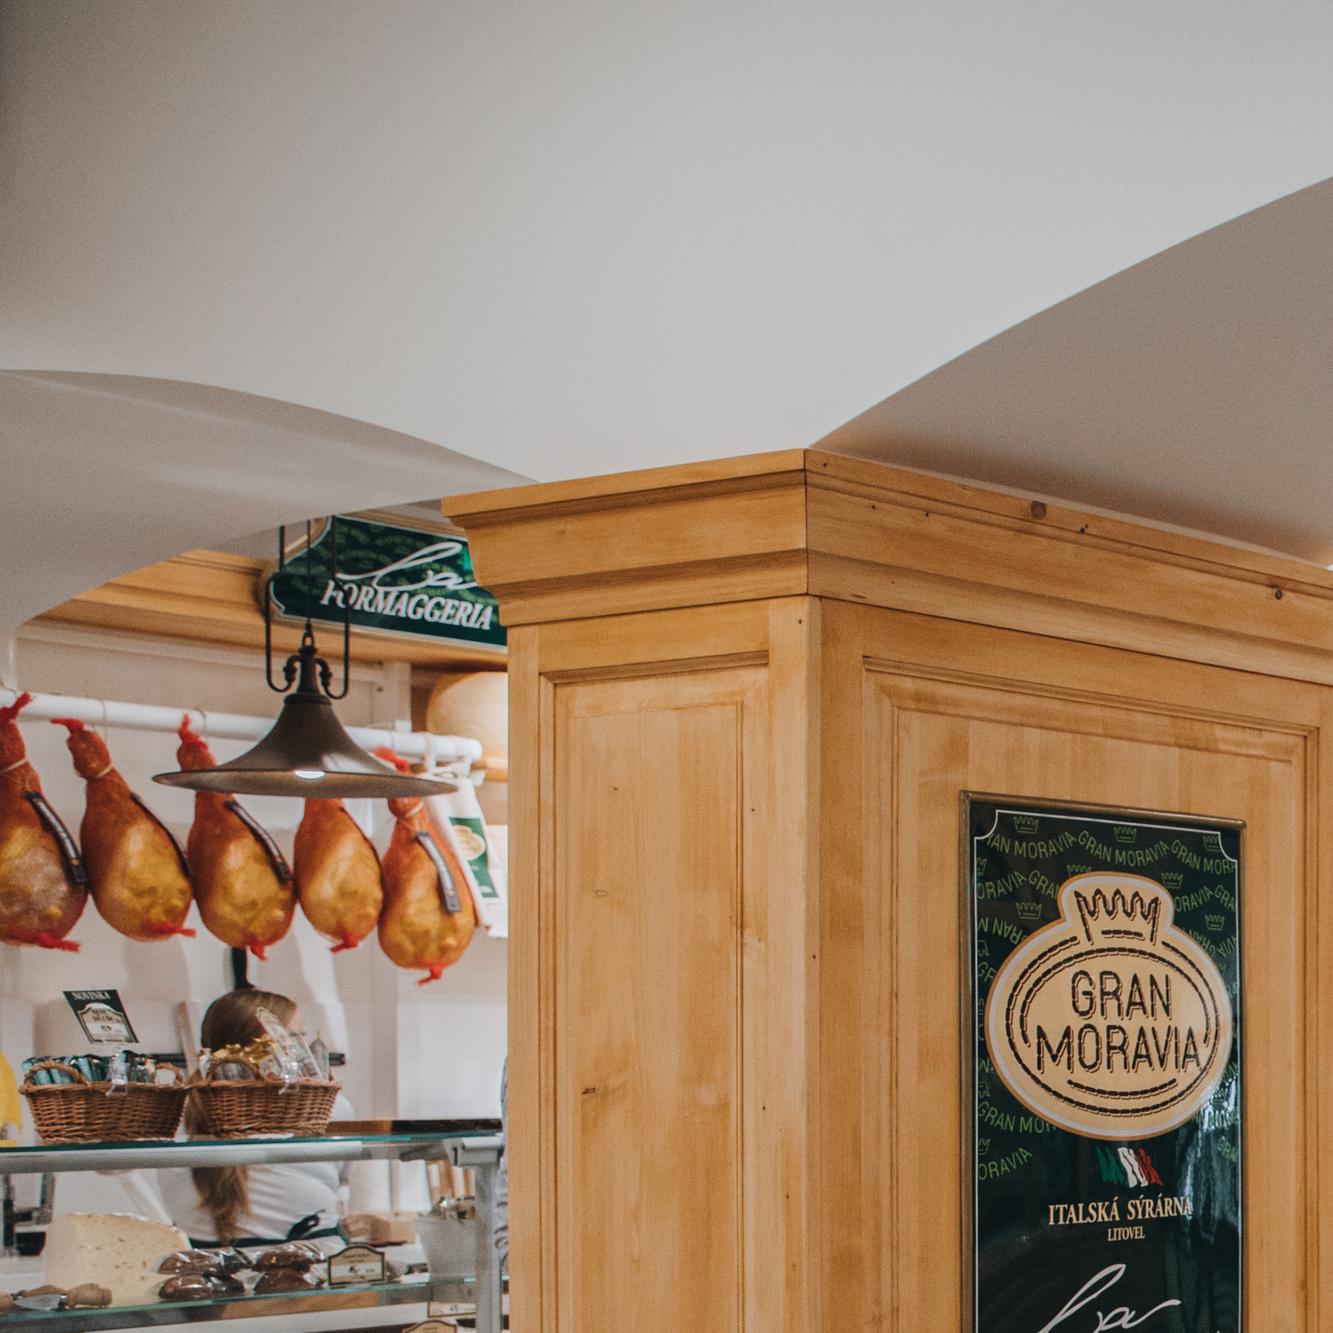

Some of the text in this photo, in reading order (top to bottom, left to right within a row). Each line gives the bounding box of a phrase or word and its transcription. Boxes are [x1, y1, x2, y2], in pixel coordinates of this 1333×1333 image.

[320, 579, 494, 631] FORMAGGERIA
[1014, 831, 1078, 859] MORAVIA
[1077, 830, 1112, 862] GRAN
[1115, 840, 1170, 867] MORAVIA
[1170, 839, 1200, 870] GRAN
[1071, 969, 1172, 1019] GRAN
[1036, 1024, 1201, 1073] MORAVIA
[1049, 1193, 1193, 1225] ITALSKÁ SÝRÁRNA
[1107, 1226, 1145, 1241] LITOVEL
